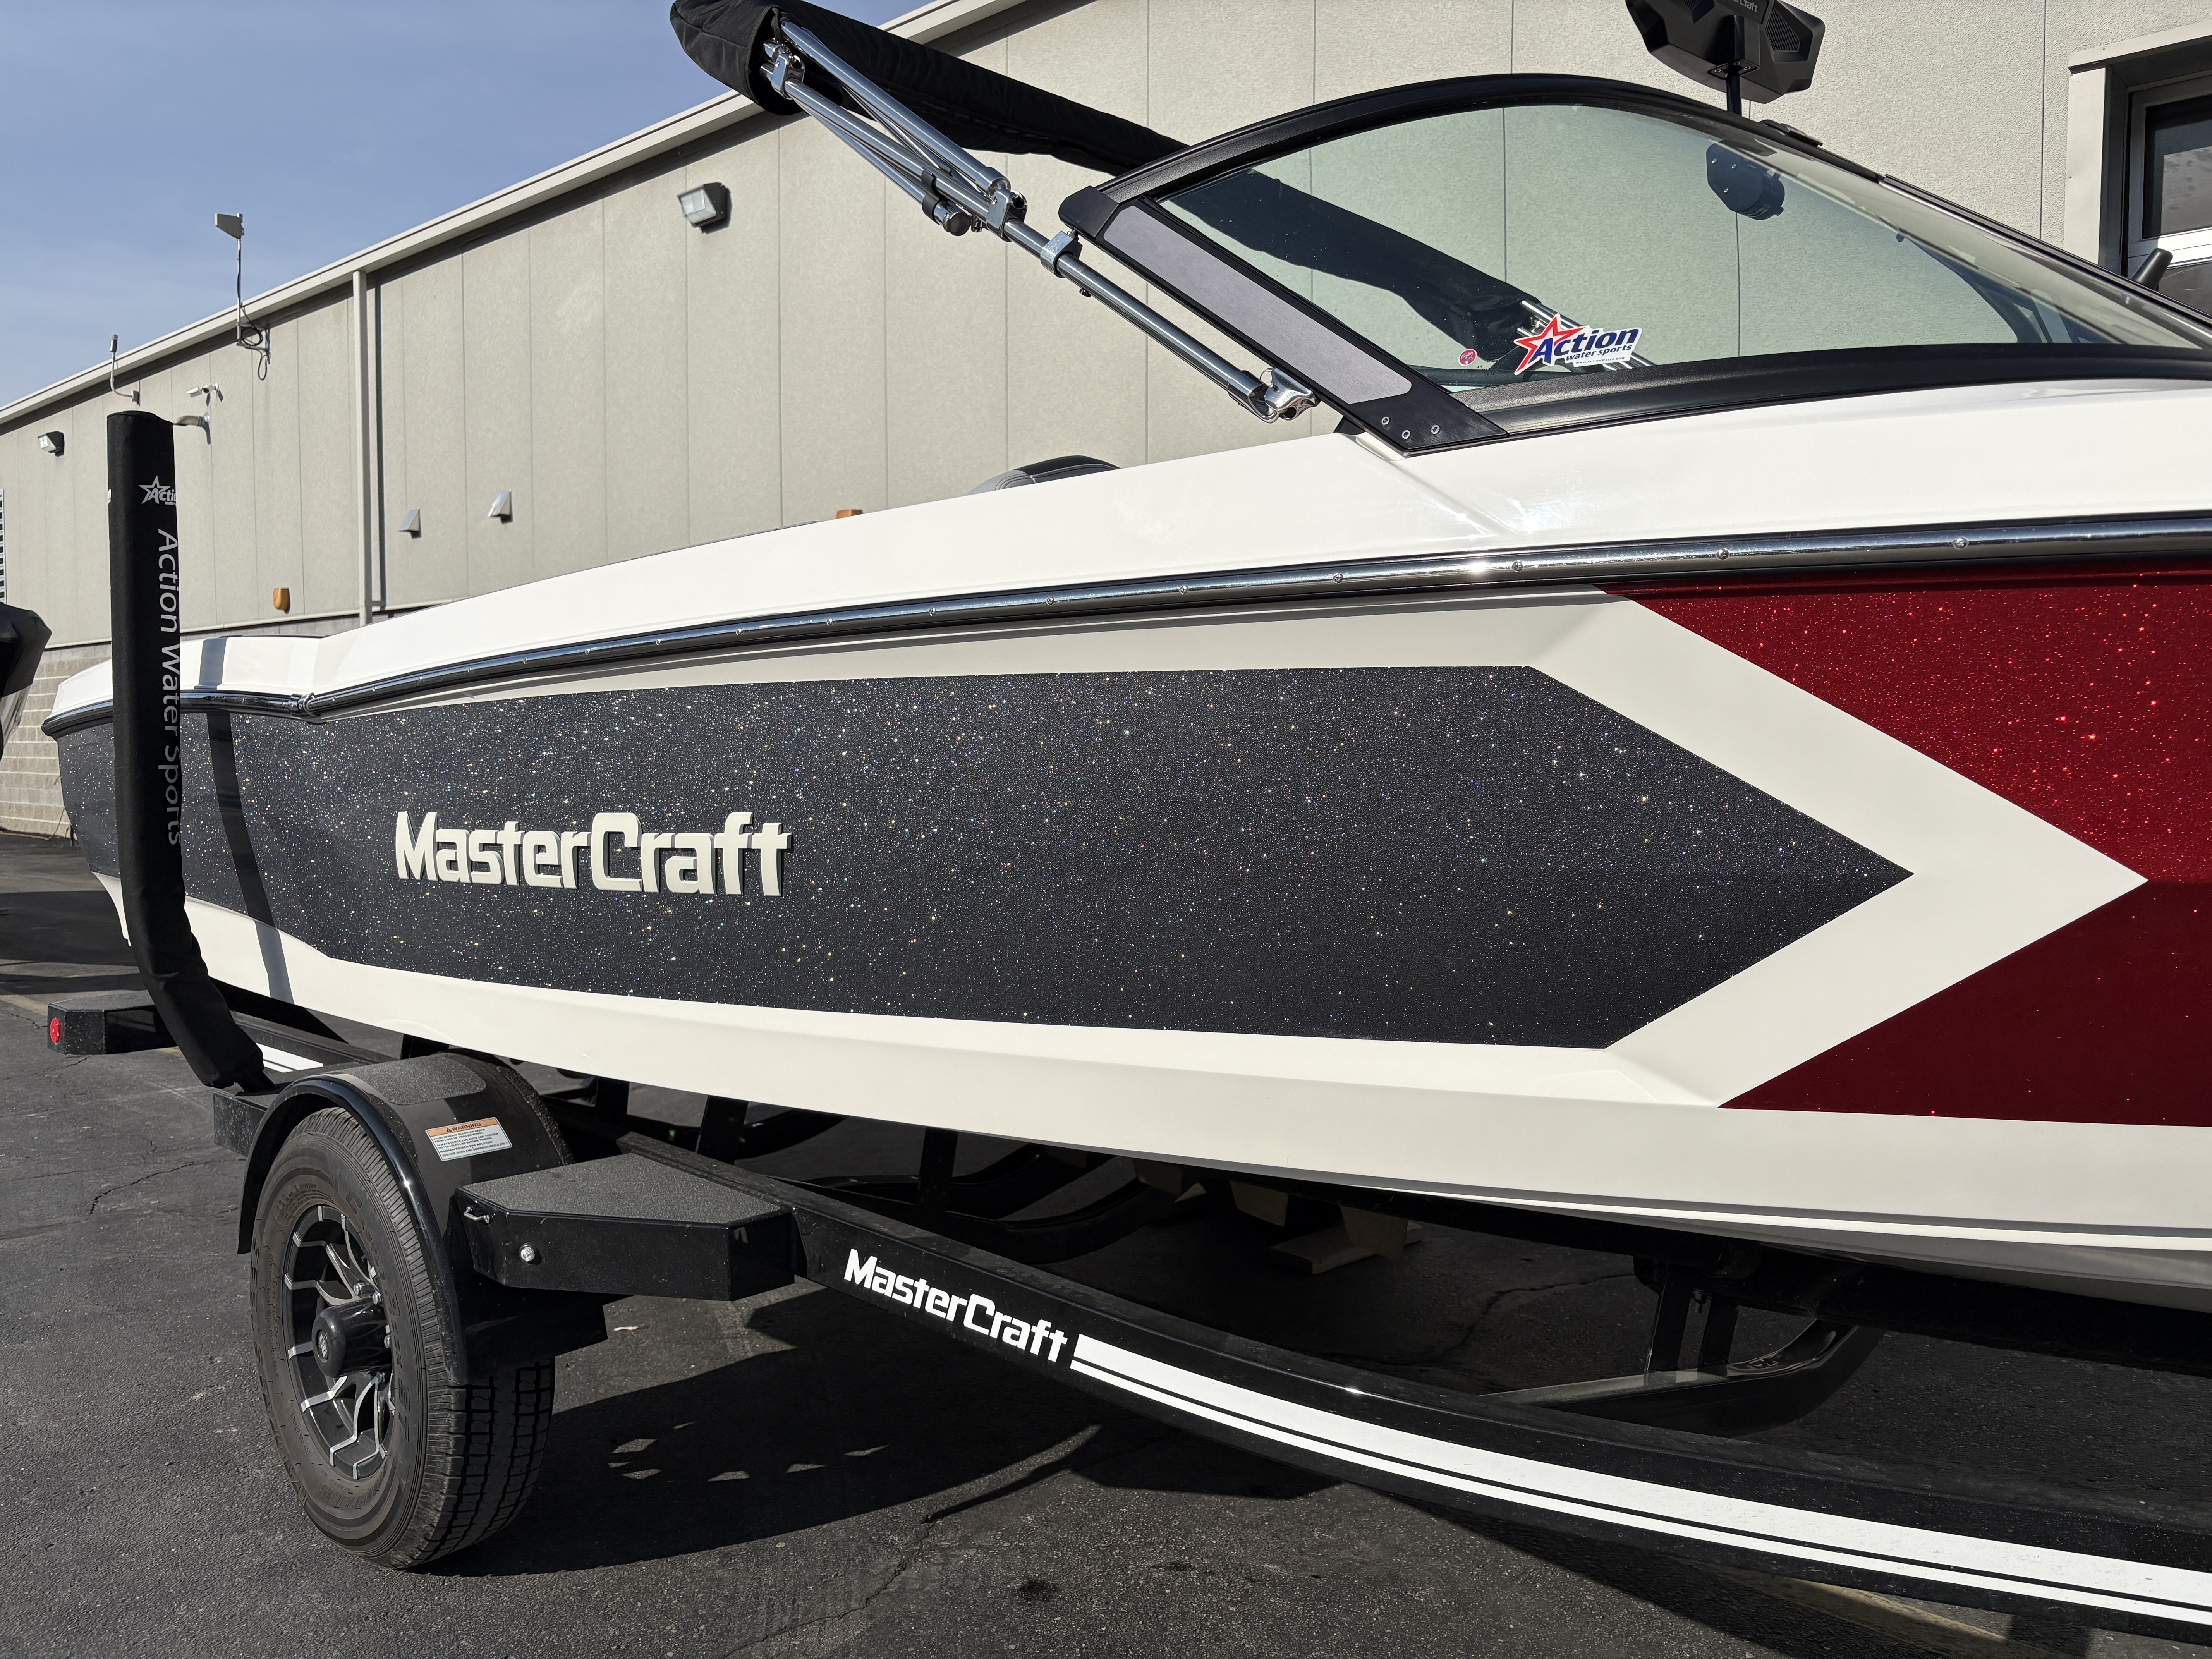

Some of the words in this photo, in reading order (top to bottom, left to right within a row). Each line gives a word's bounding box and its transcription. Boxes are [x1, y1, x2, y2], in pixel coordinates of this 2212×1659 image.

[1527, 329, 1639, 364] Action
[1566, 351, 1596, 361] water
[1598, 345, 1632, 355] sports
[158, 529, 179, 632] Action
[161, 644, 180, 737] Water
[158, 745, 180, 845] Sports
[395, 810, 792, 896] MasterCraft
[451, 1122, 481, 1131] WARNING
[844, 1248, 1068, 1362] MasterCraft
